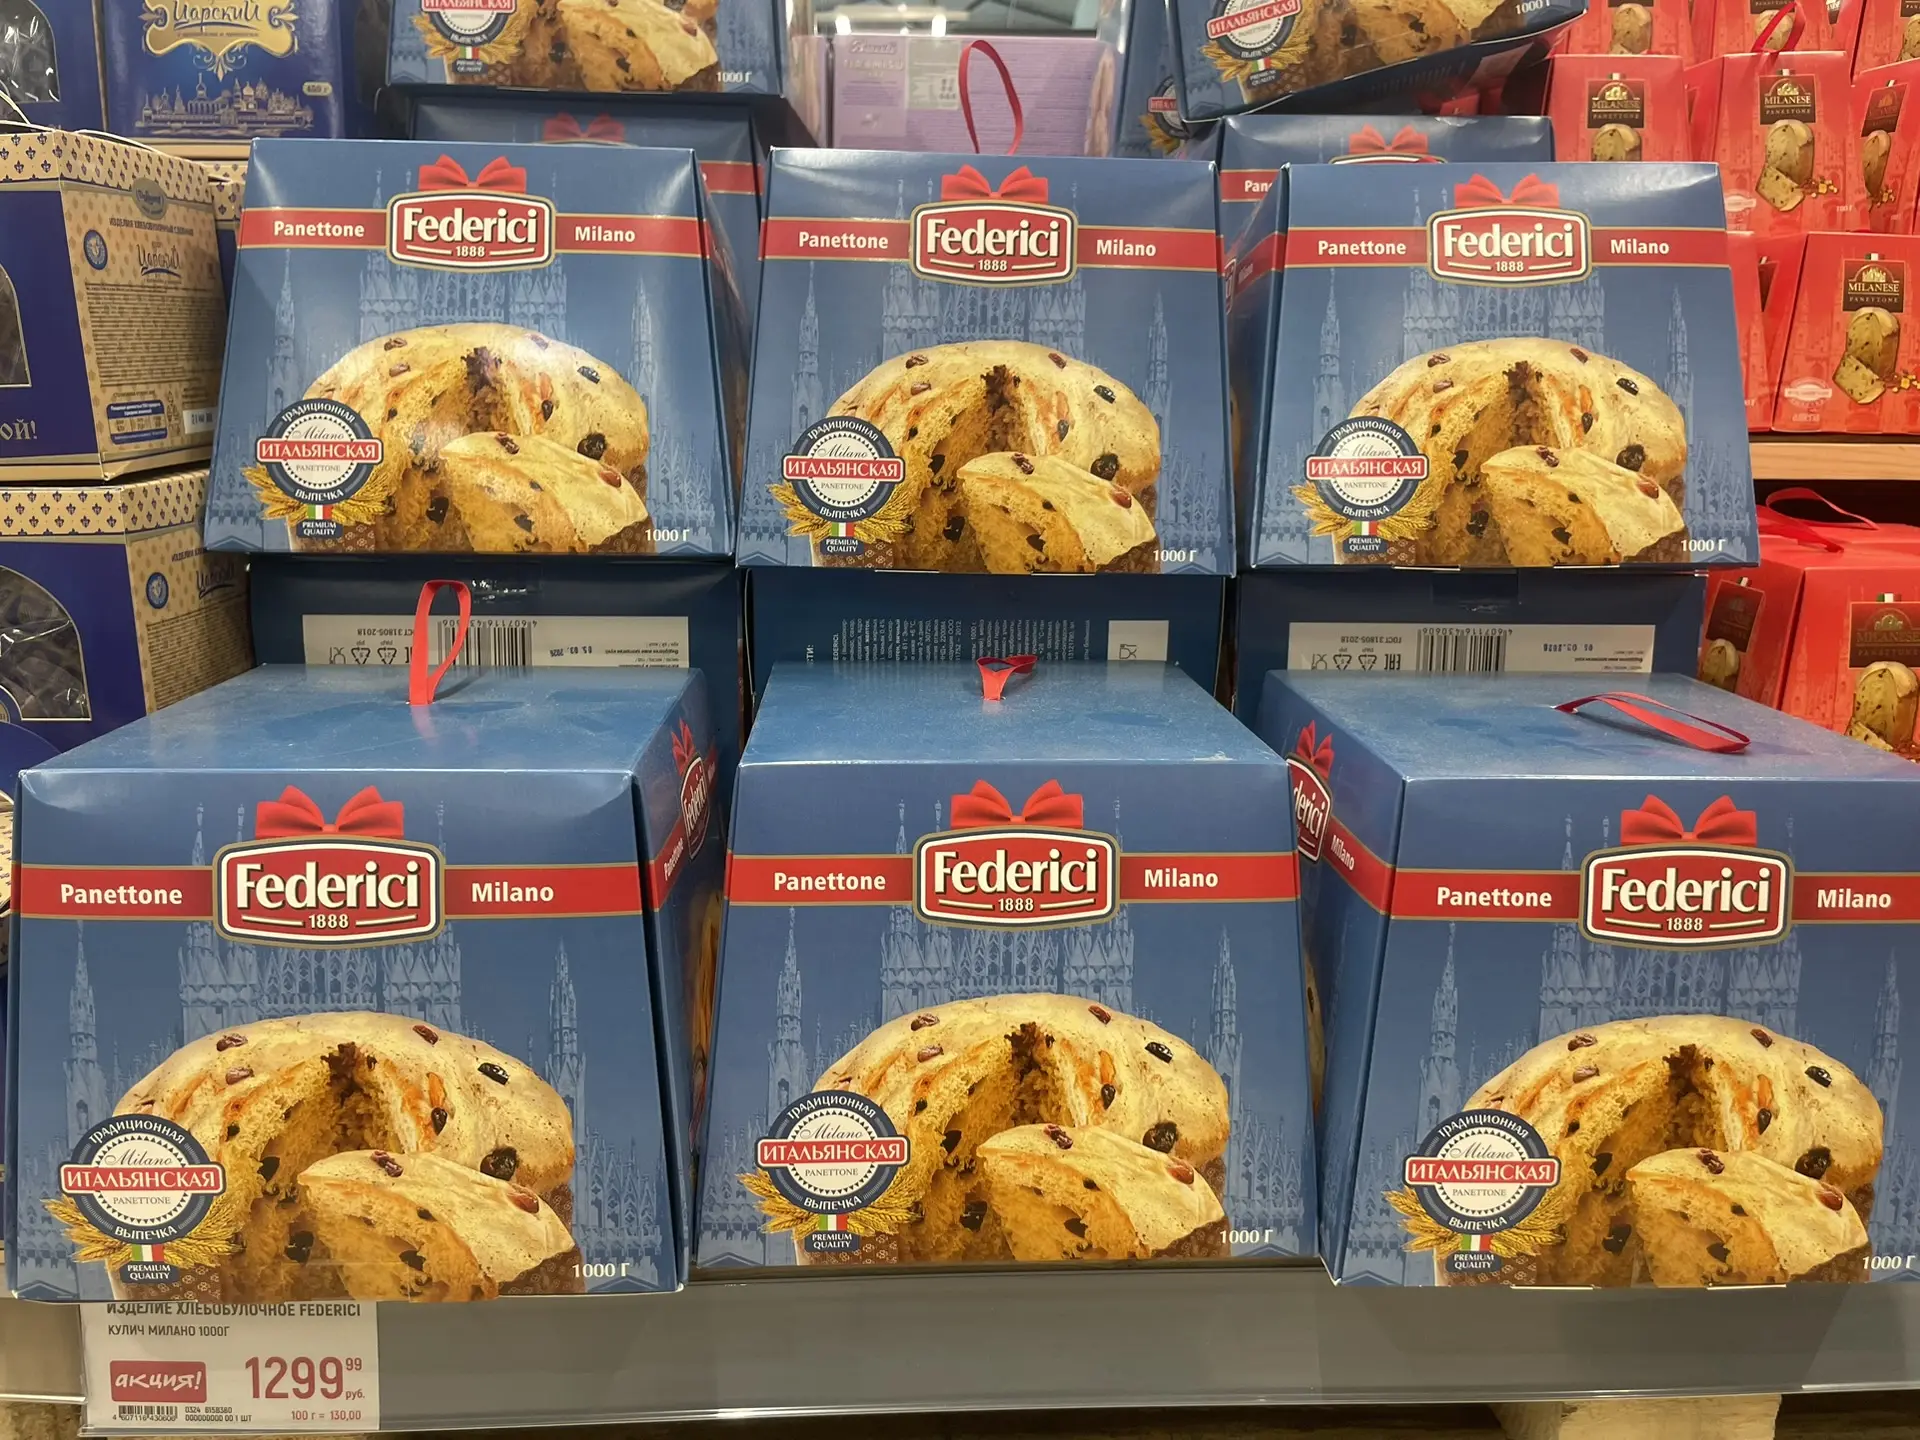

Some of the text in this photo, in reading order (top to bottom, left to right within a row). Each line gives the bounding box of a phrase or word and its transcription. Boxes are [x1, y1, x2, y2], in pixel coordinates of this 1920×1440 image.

[1515, 0, 1547, 15] 1000
[1211, 0, 1297, 35] ИТАЛЬЯНСКАЯ
[716, 72, 743, 83] 1000
[1764, 96, 1811, 105] MILANESE
[273, 207, 636, 244] Panettone Federici Milano
[799, 218, 1156, 257] Panettone Federici Milano
[1318, 222, 1670, 257] Panettone Federici Milano
[455, 245, 485, 258] 1888
[978, 260, 1007, 271] 1888
[1495, 261, 1524, 272] 1888
[1848, 283, 1900, 293] MILANESE
[282, 402, 355, 423] ТРАДИЦИОННАЯ
[292, 425, 345, 440] Milano
[807, 420, 879, 441] ТРАДИЦИОННАЯ
[1331, 420, 1402, 441] ТРАДИЦИОННАЯ
[262, 444, 376, 458] ИТАЛЬЯНСКАЯ
[817, 444, 868, 458] Milano
[1341, 444, 1392, 457] Milano
[296, 464, 341, 472] PANETTONE
[788, 461, 898, 477] ИТАЛЬЯНСКАЯ
[1311, 460, 1422, 475] ИТАЛЬЯНСКАЯ
[820, 482, 864, 490] PANETTONE
[1344, 481, 1388, 489] PANETTONE
[295, 488, 344, 501] ВЫПЕЧКА
[819, 506, 866, 519] ВЫПЕЧКА
[1343, 505, 1390, 518] ВЫПЕЧКА
[304, 528, 336, 536] QUALITY
[645, 529, 679, 542] 1000
[826, 538, 858, 546] PREMIUM
[1349, 537, 1381, 545] PREMIUM
[1681, 539, 1715, 552] 1000
[1153, 550, 1186, 562] 1000
[442, 619, 482, 627] 43606
[487, 619, 527, 628] 607116
[357, 628, 403, 636] 31805-2018
[1340, 636, 1402, 644] ГОСТ 31805-2018
[1293, 780, 1326, 838] derici
[1331, 834, 1355, 871] Milano
[774, 848, 1219, 893] Panettone Federici Milano
[60, 860, 554, 908] Panettone Federici Milano
[1437, 867, 1891, 912] Panettone Federici Milano
[998, 898, 1034, 911] 1888
[308, 914, 349, 928] 1888
[1666, 917, 1703, 931] 1888
[787, 1095, 876, 1120] ТРАДИЦИОННАЯ
[89, 1119, 185, 1144] ТРАДИЦИОННАЯ
[800, 1123, 864, 1139] Milano
[1438, 1114, 1529, 1139] ТРАДИЦИОННАЯ
[763, 1143, 900, 1161] ИТАЛЬЯНСКАЯ
[1450, 1142, 1515, 1159] Milano
[104, 1149, 173, 1166] Milano
[805, 1168, 859, 1177] PANETTONE
[1411, 1163, 1551, 1181] ИТАЛЬЯНСКАЯ
[67, 1171, 215, 1188] ИТАЛЬЯНСКАЯ
[1452, 1188, 1507, 1197] PANETTONE
[113, 1196, 171, 1205] PANETTONE
[804, 1195, 862, 1210] ВЫПЕЧКА
[1448, 1216, 1508, 1230] ВЫПЕЧКА
[115, 1225, 177, 1240] ВЫПЕЧКА
[812, 1233, 852, 1241] PREMIUM
[1220, 1230, 1260, 1243] 1000
[813, 1241, 851, 1249] QUALITY
[1454, 1253, 1494, 1261] PREMIUM
[1862, 1256, 1901, 1270] 1000
[127, 1264, 171, 1272] PREMIUM
[572, 1263, 616, 1278] 1000
[1455, 1261, 1492, 1269] QUALITY
[129, 1272, 170, 1280] QUALITY
[106, 1303, 361, 1317] ИЗДЕЛИЕ ХЛЕБОБУЛОЧНОЕ FEDERICI
[108, 1325, 230, 1337] КУЛИЧ МИЛАНО 1000Г
[245, 1356, 362, 1399] 1299 99
[345, 1390, 365, 1400] руб.
[292, 1410, 307, 1421] 100
[330, 1410, 362, 1421] 130,00
